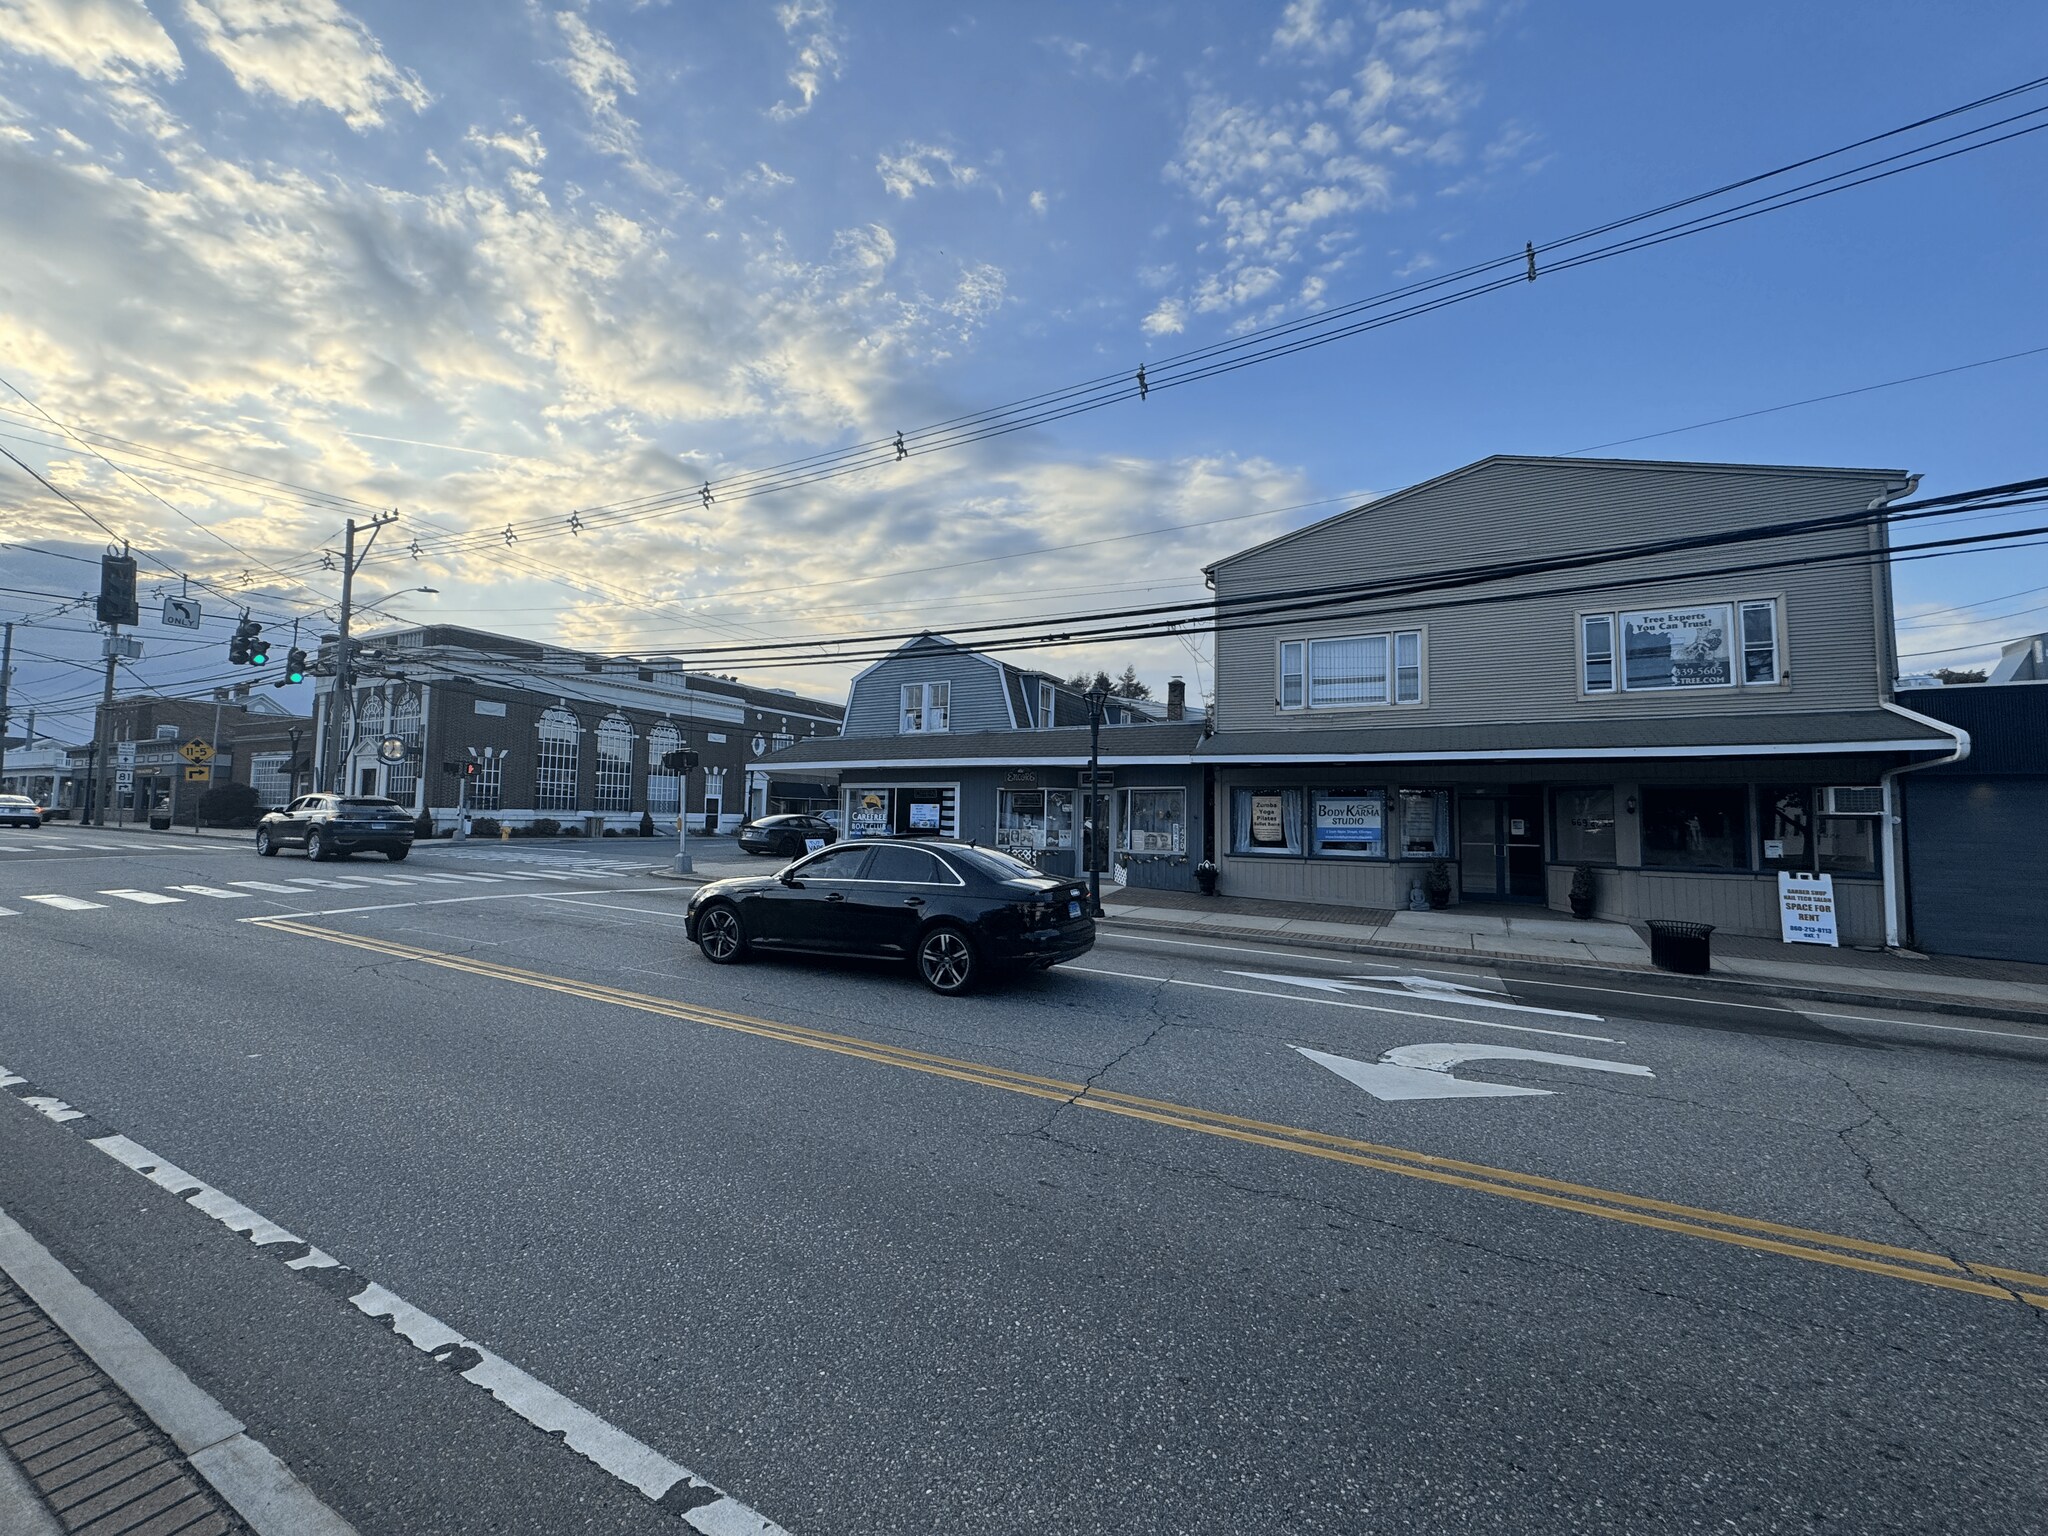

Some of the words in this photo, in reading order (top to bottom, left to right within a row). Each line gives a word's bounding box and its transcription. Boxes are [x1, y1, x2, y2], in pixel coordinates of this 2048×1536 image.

[167, 616, 195, 627] ONLY
[1643, 616, 1665, 624] Tree
[1668, 613, 1706, 622] Experts
[1659, 622, 1678, 630] Can
[1682, 619, 1712, 628] Trust!
[186, 747, 207, 756] 11-5
[118, 773, 131, 781] 81
[1318, 804, 1345, 817] BODY
[1346, 804, 1380, 817] KARMA
[851, 811, 887, 820] CAREFREE
[1331, 817, 1364, 825] STUDIO
[1785, 903, 1813, 911] SPACE
[1798, 913, 1820, 921] RENT
